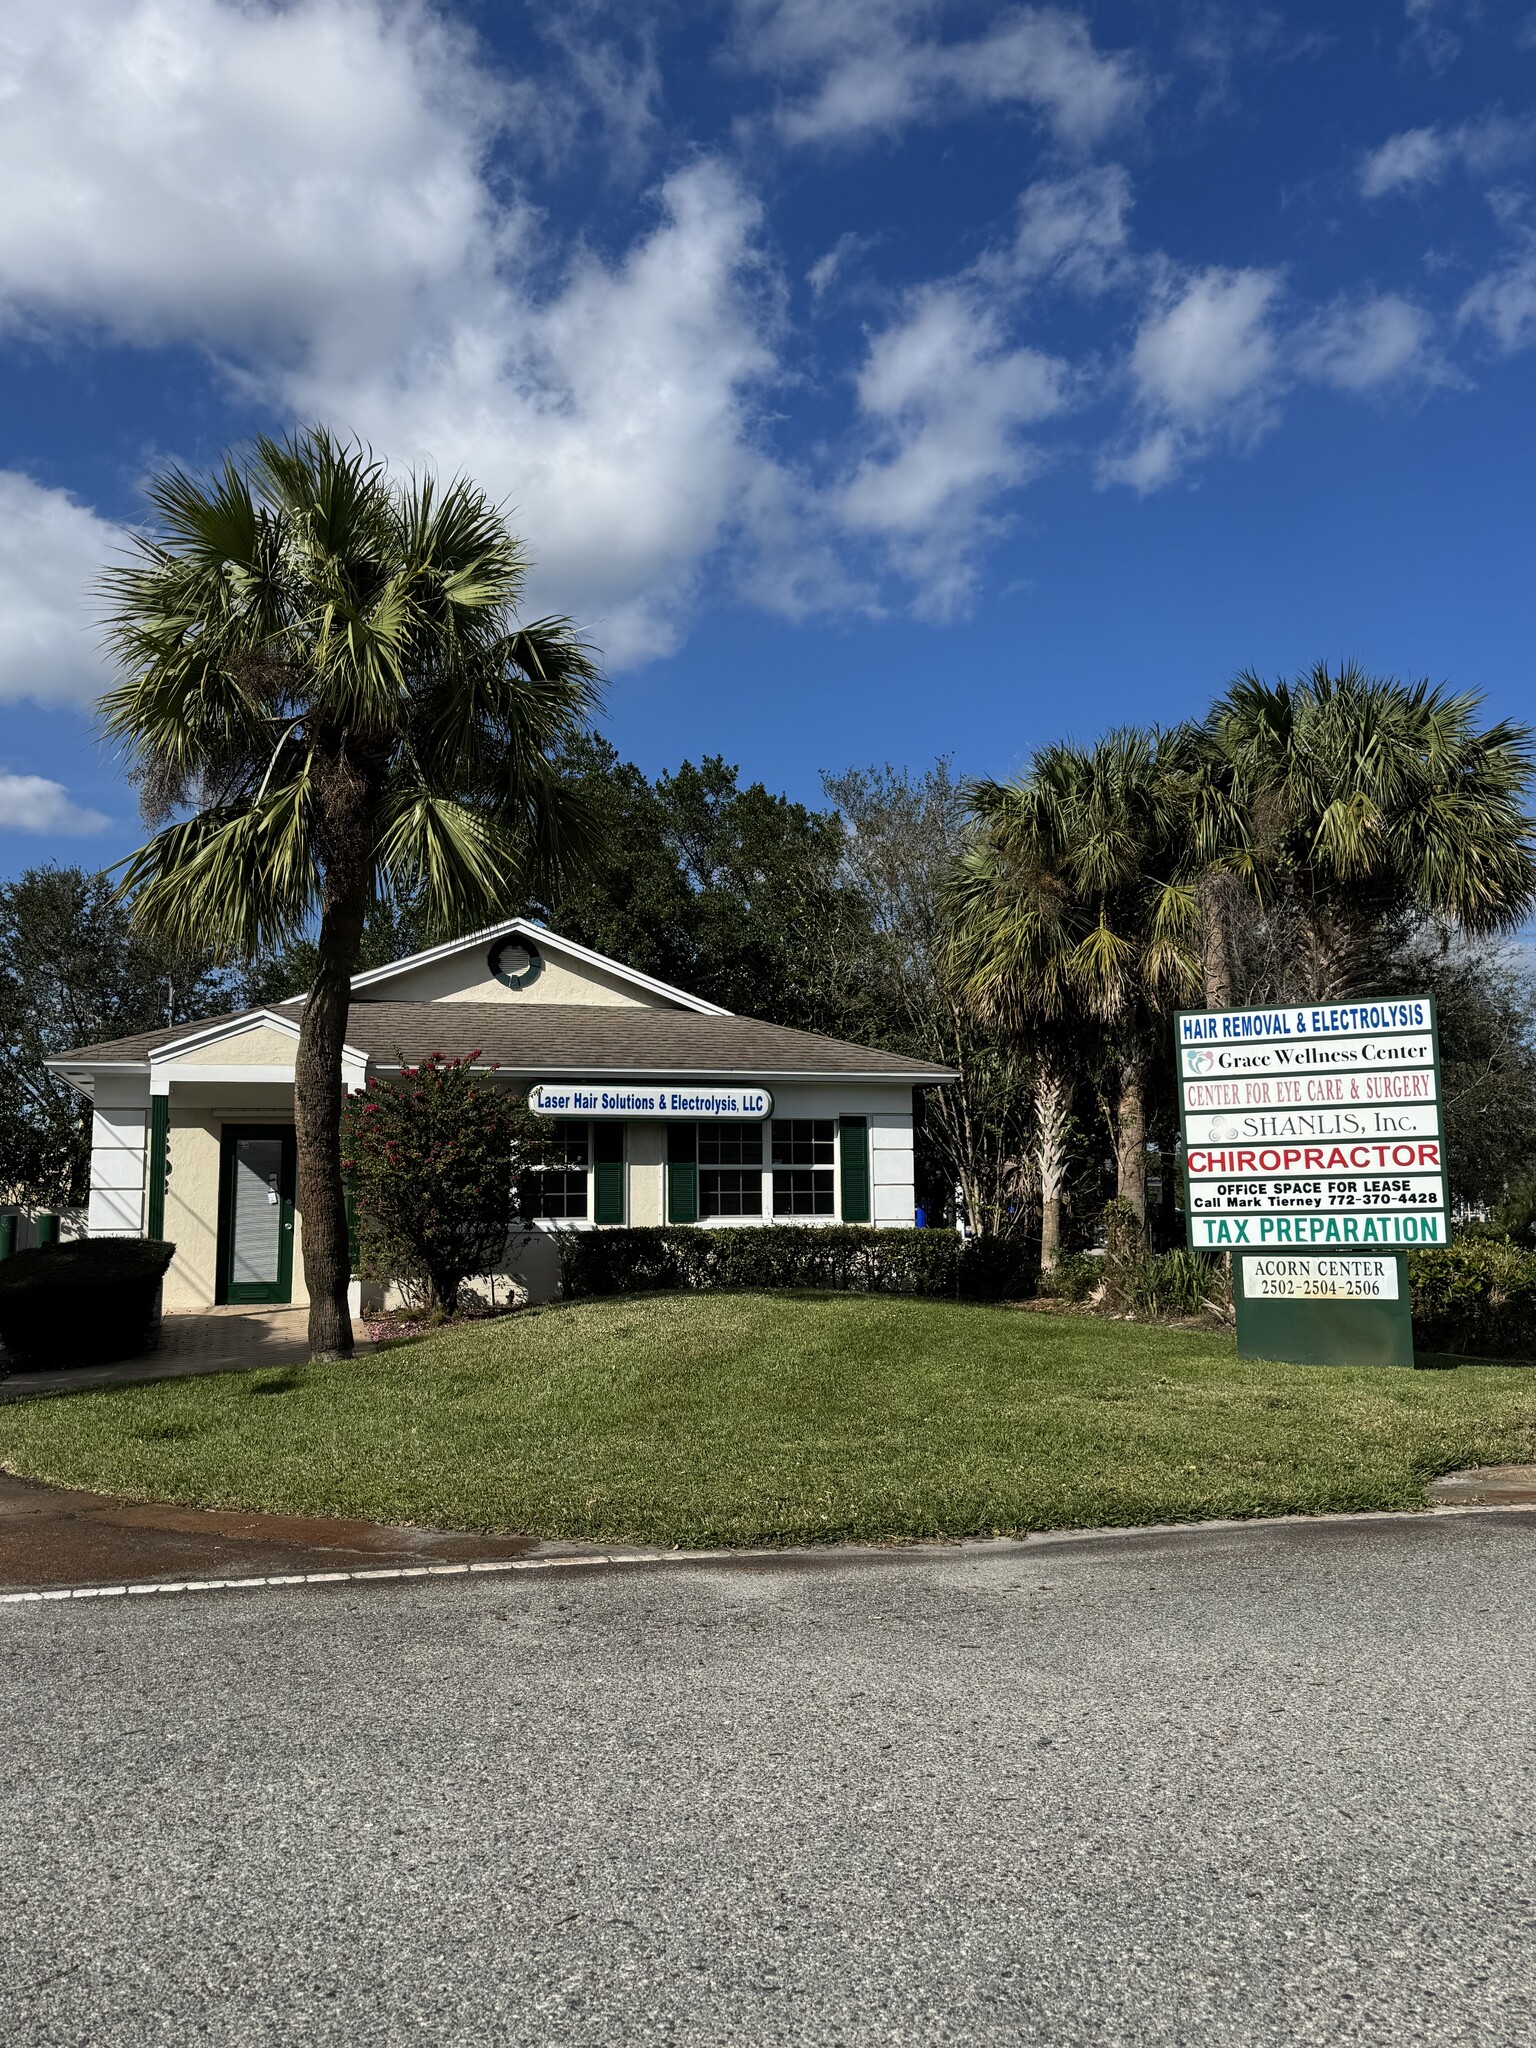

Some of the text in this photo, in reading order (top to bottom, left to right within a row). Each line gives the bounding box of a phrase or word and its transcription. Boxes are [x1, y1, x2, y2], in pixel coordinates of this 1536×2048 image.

[1183, 1003, 1423, 1040] HAIR REMOVAL & ELECTROLYSIS
[1218, 1044, 1427, 1068] Grace Wellness Center
[1188, 1074, 1430, 1106] CENTER FOR EYE CARE & SURGERY
[538, 1093, 763, 1114] Laser Hair Solutions & Electrolysis, LLC
[1243, 1113, 1417, 1137] SHANLIS, Inc.
[1188, 1144, 1440, 1172] CHIROPRACTOR
[1217, 1181, 1410, 1195] OFFICE SPACE FOR LEASE
[1194, 1193, 1437, 1208] Call Mark Tierney 772-370-4428
[1203, 1216, 1438, 1243] TAX PREPARATION
[1255, 1261, 1385, 1276] ACORN CENTER
[1262, 1280, 1380, 1295] 2502-2504-2506
